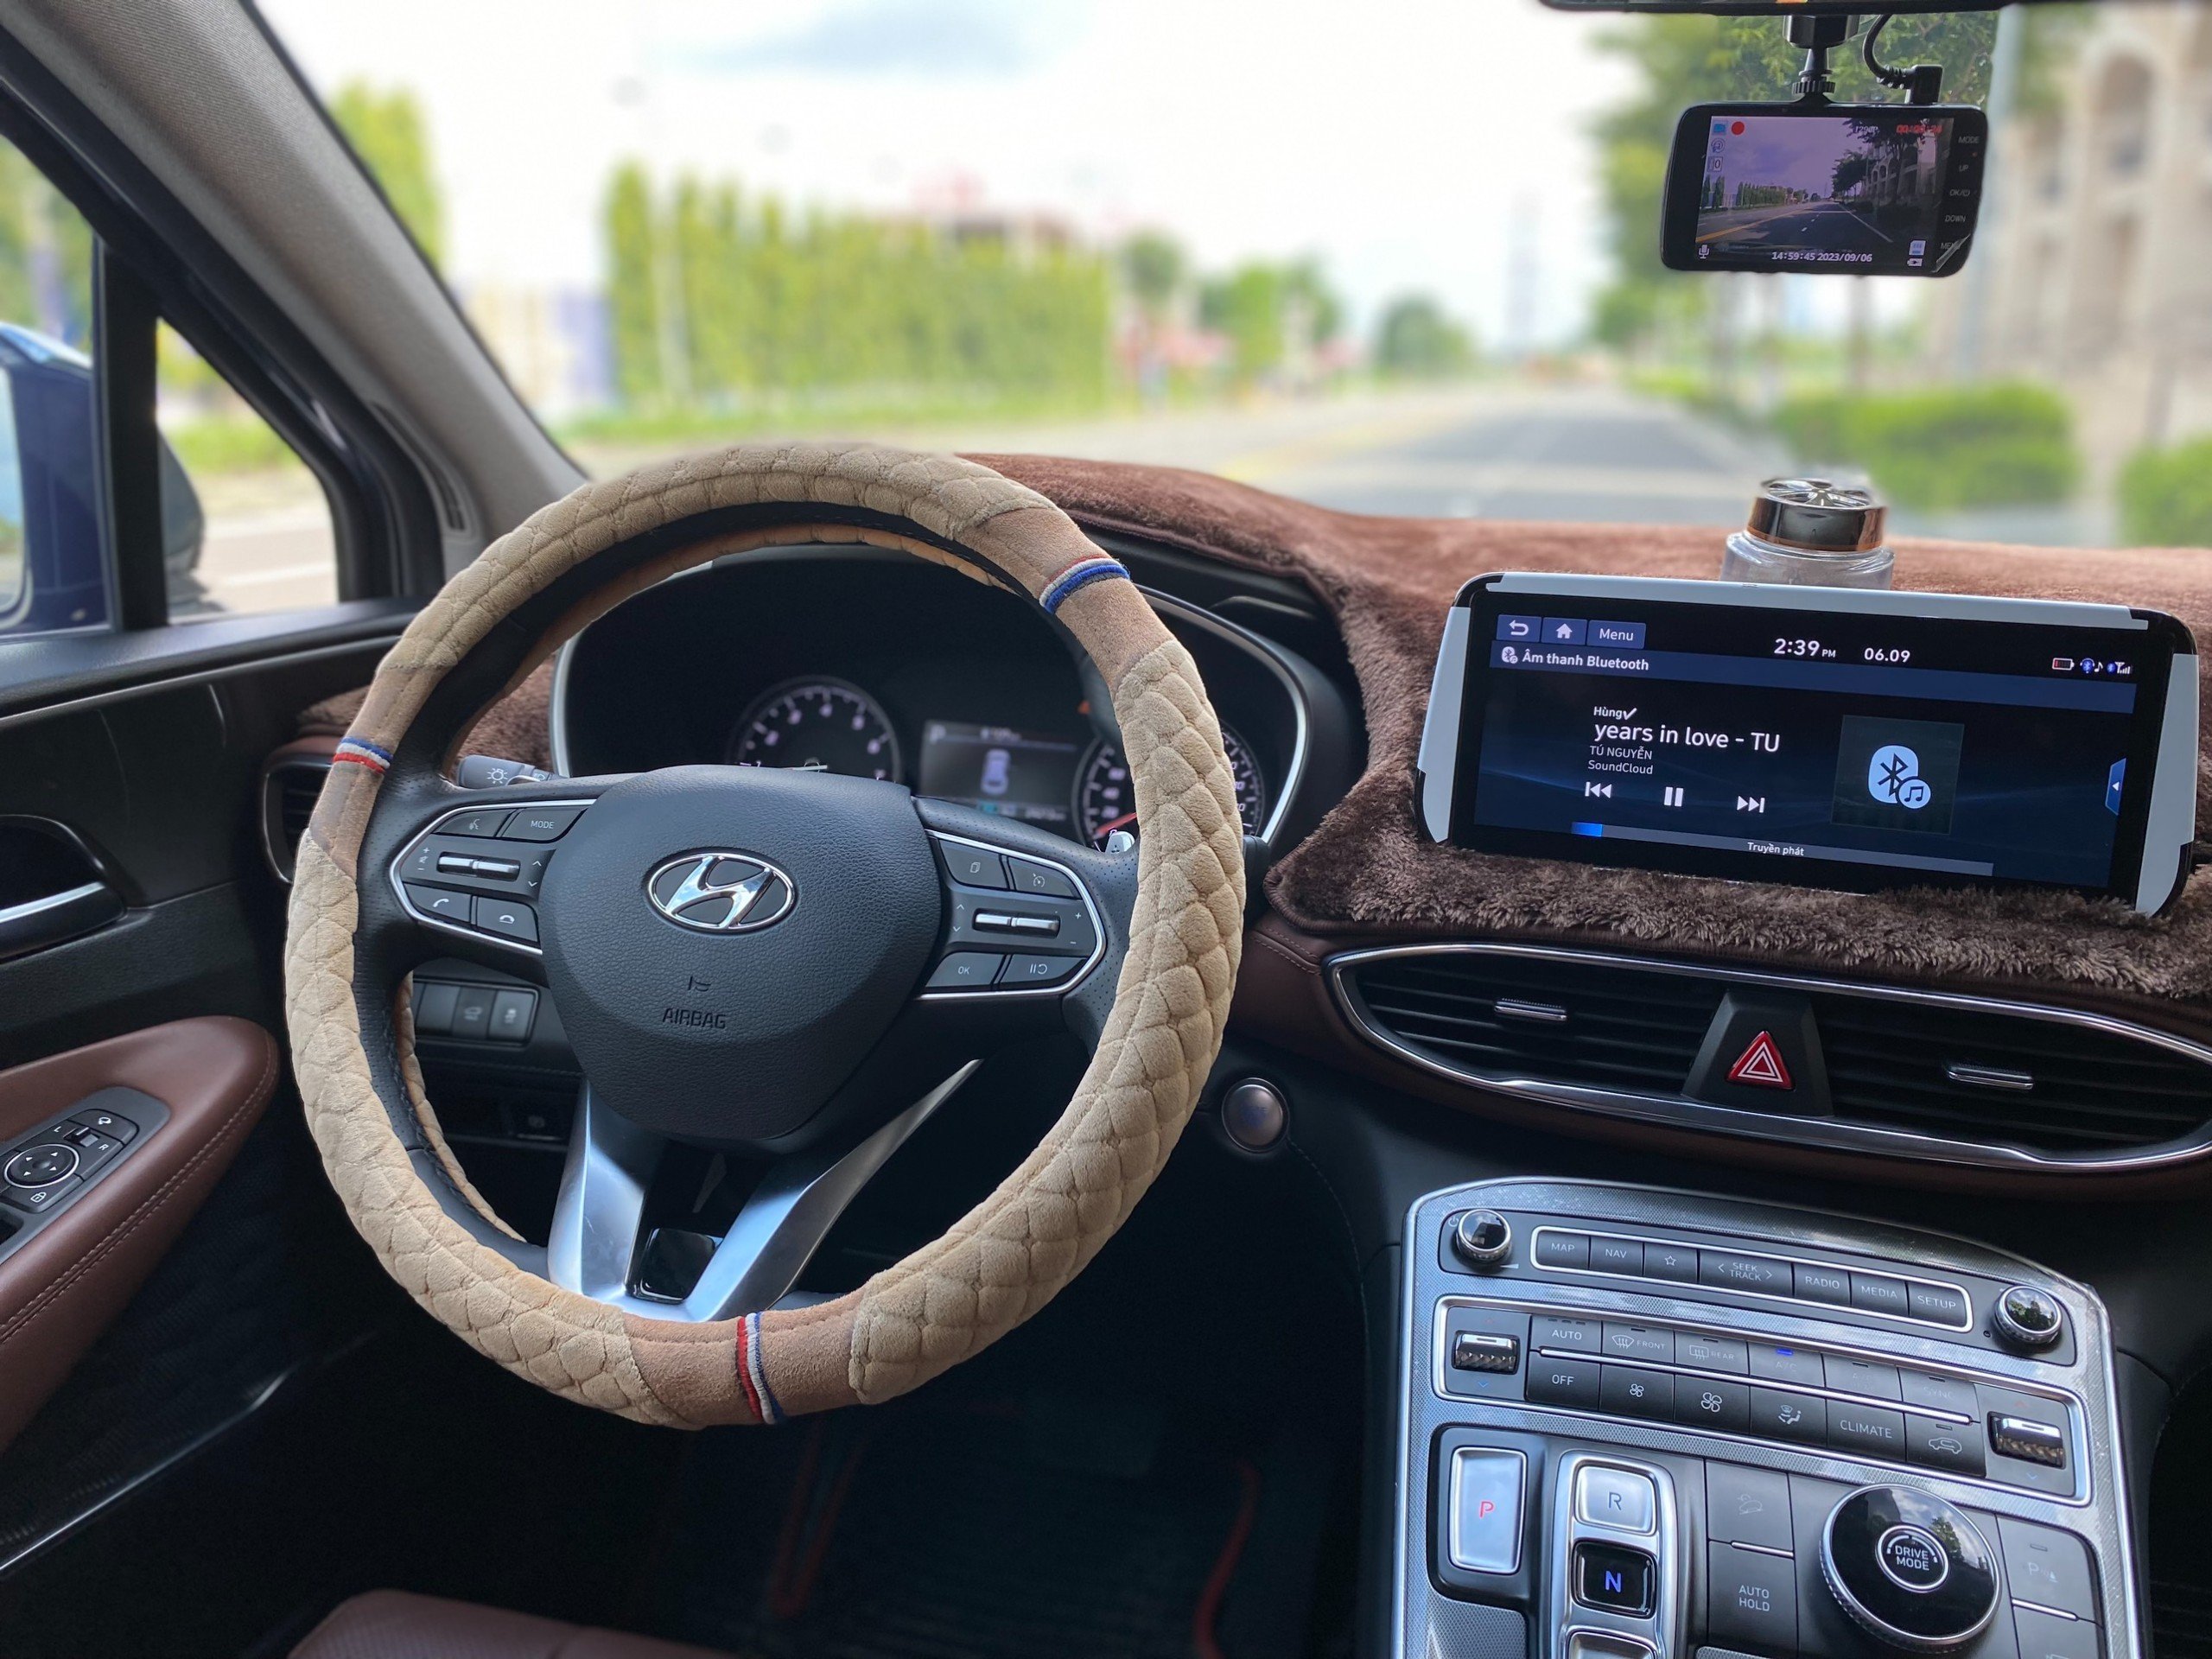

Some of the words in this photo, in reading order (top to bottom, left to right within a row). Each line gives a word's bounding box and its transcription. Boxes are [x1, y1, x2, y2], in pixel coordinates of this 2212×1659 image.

[1958, 136, 1980, 144] MODE
[1945, 214, 1967, 223] DOWN
[1771, 251, 1815, 261] 14:59:45
[1817, 252, 1872, 263] 2023/09/06
[1599, 627, 1634, 642] Menu
[1774, 638, 1820, 657] 2:39
[1821, 649, 1836, 658] PM
[1864, 647, 1910, 663] 06.09
[1522, 649, 1543, 664] Âm
[1547, 652, 1583, 666] thanh
[1586, 655, 1649, 671] Bluetooth
[1594, 723, 1654, 742] years
[1660, 724, 1678, 744] in
[1685, 727, 1729, 748] love
[1751, 732, 1780, 753] TU
[1589, 744, 1605, 756] TÚ
[1606, 746, 1653, 760] NGUYỄN
[1587, 760, 1654, 775] SoundCloud
[531, 819, 555, 830] MODE
[1747, 842, 1780, 854] Truyền
[1782, 846, 1805, 856] phát
[957, 966, 970, 975] OK
[663, 1007, 727, 1029] AIRBAG
[1551, 1243, 1575, 1253] MAP
[1605, 1249, 1627, 1259] NAV
[1732, 1262, 1758, 1273] SEEK
[1730, 1269, 1762, 1281] TRACK
[1805, 1275, 1840, 1289] RADIO
[1861, 1285, 1897, 1299] MEDIA
[1917, 1294, 1956, 1309] SETUP
[1551, 1329, 1582, 1340] AUTO
[1637, 1339, 1665, 1351] FRONT
[1711, 1351, 1735, 1360] REAR
[1776, 1361, 1797, 1373] A/C
[1551, 1374, 1574, 1386] OFF
[1840, 1420, 1893, 1439] CLIMATE
[1608, 1491, 1623, 1511] R
[1478, 1500, 1495, 1518] P
[1895, 1545, 1929, 1560] DRIVE
[1896, 1555, 1930, 1571] MODE
[1604, 1570, 1623, 1593] N
[1738, 1584, 1770, 1599] AUTO
[1738, 1597, 1770, 1612] HOLD
